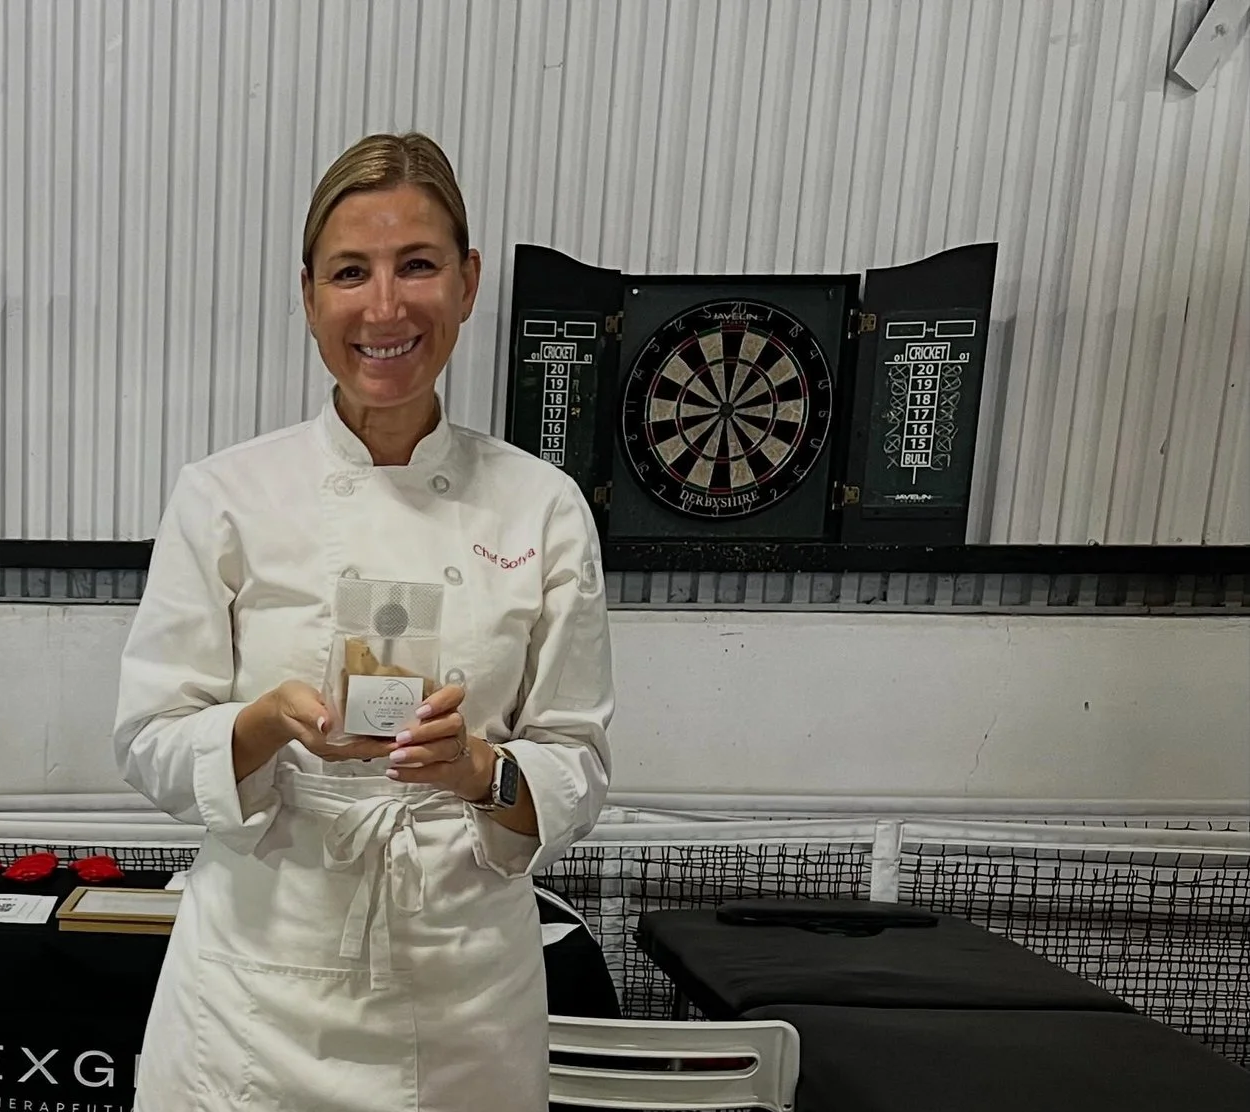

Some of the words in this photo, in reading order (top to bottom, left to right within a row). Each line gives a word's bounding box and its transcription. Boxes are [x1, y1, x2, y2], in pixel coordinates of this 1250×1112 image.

[544, 346, 573, 359] CRICKET
[909, 346, 946, 360] CRICKET
[917, 365, 934, 375] 20
[917, 379, 932, 389] 19
[916, 394, 930, 405] 18
[914, 410, 929, 419] 17
[912, 424, 928, 434] 16
[911, 439, 926, 449] 15
[905, 454, 927, 464] BULL
[679, 489, 760, 508] DERBYSHIRE
[473, 544, 497, 564] Chef
[501, 548, 535, 569] Sofya
